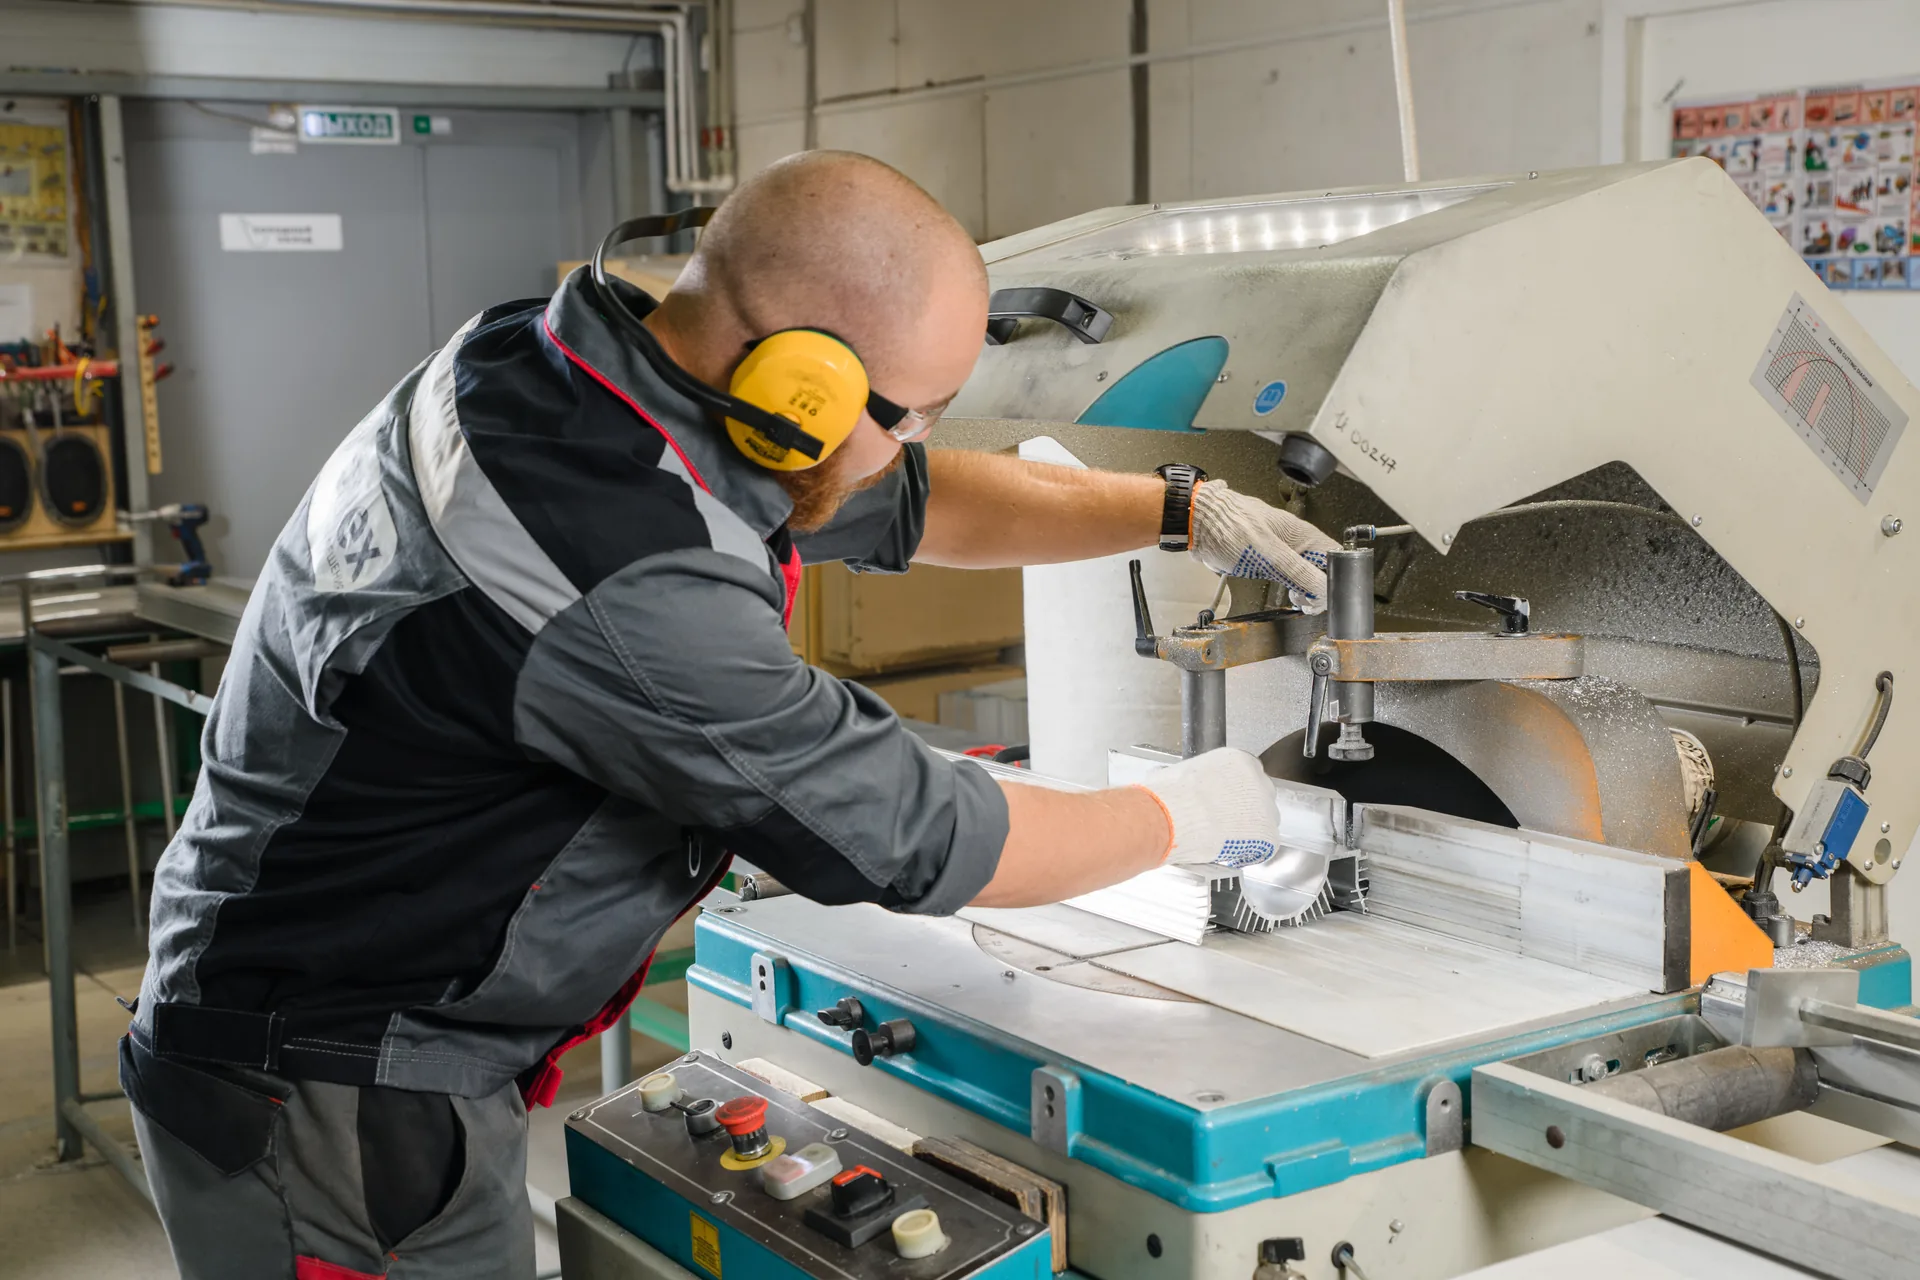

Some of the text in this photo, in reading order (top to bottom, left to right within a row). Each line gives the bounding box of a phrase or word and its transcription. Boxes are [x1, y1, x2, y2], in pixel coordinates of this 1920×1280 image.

[306, 114, 390, 137] ЫХОД
[1856, 368, 1873, 388] DIAGRAM
[1350, 430, 1397, 474] 00247
